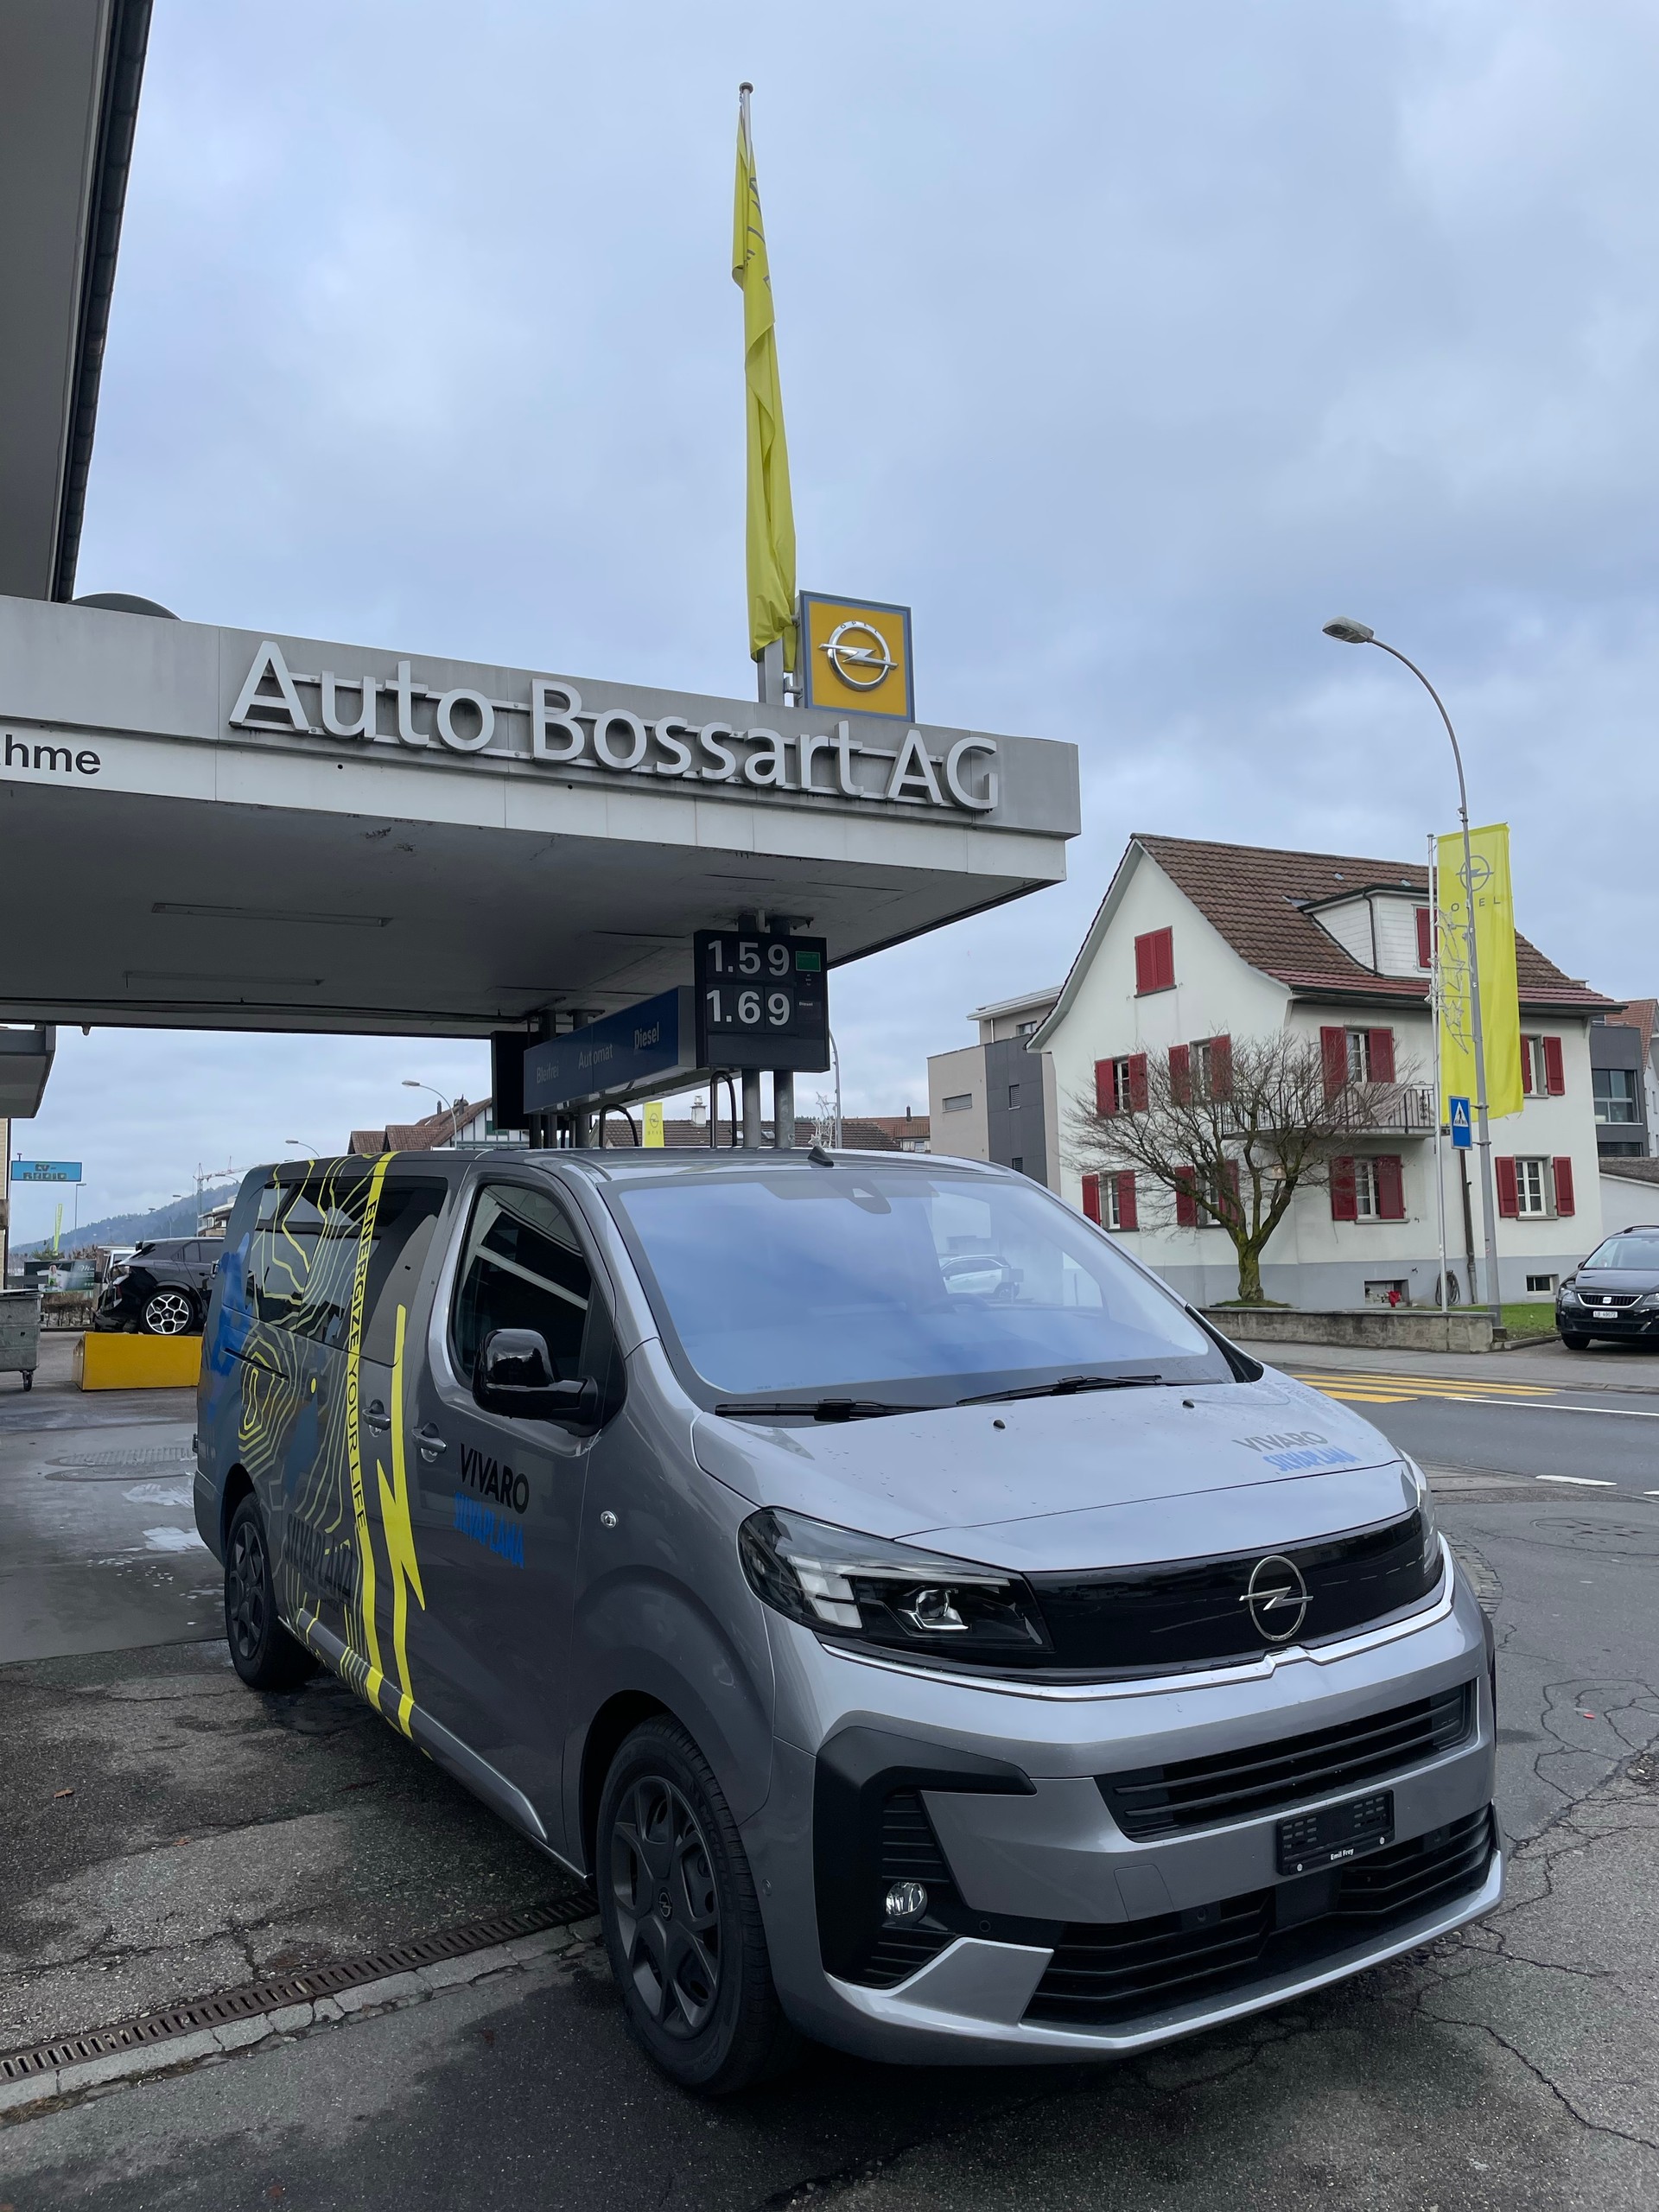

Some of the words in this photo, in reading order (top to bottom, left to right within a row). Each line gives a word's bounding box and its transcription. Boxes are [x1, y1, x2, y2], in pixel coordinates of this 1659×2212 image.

[840, 621, 879, 635] OPEL
[229, 640, 495, 752] Auto
[531, 678, 864, 797] Bossart
[885, 729, 999, 811] AG
[0, 734, 101, 775] hme
[1451, 896, 1501, 912] OEL
[708, 940, 790, 976] 1.59
[706, 989, 790, 1026] 1.69
[537, 1061, 560, 1084] Bleifrei
[578, 1044, 613, 1070] Automat
[634, 1021, 660, 1050] Diesel
[350, 1199, 378, 1351] ENERGIZE
[348, 1359, 359, 1453] YOUR
[1231, 1431, 1328, 1452] VIVARO
[351, 1461, 366, 1532] LIFE
[461, 1443, 530, 1514] VIVARO
[1331, 1851, 1343, 1860] Emil
[1343, 1848, 1354, 1857] Frey
